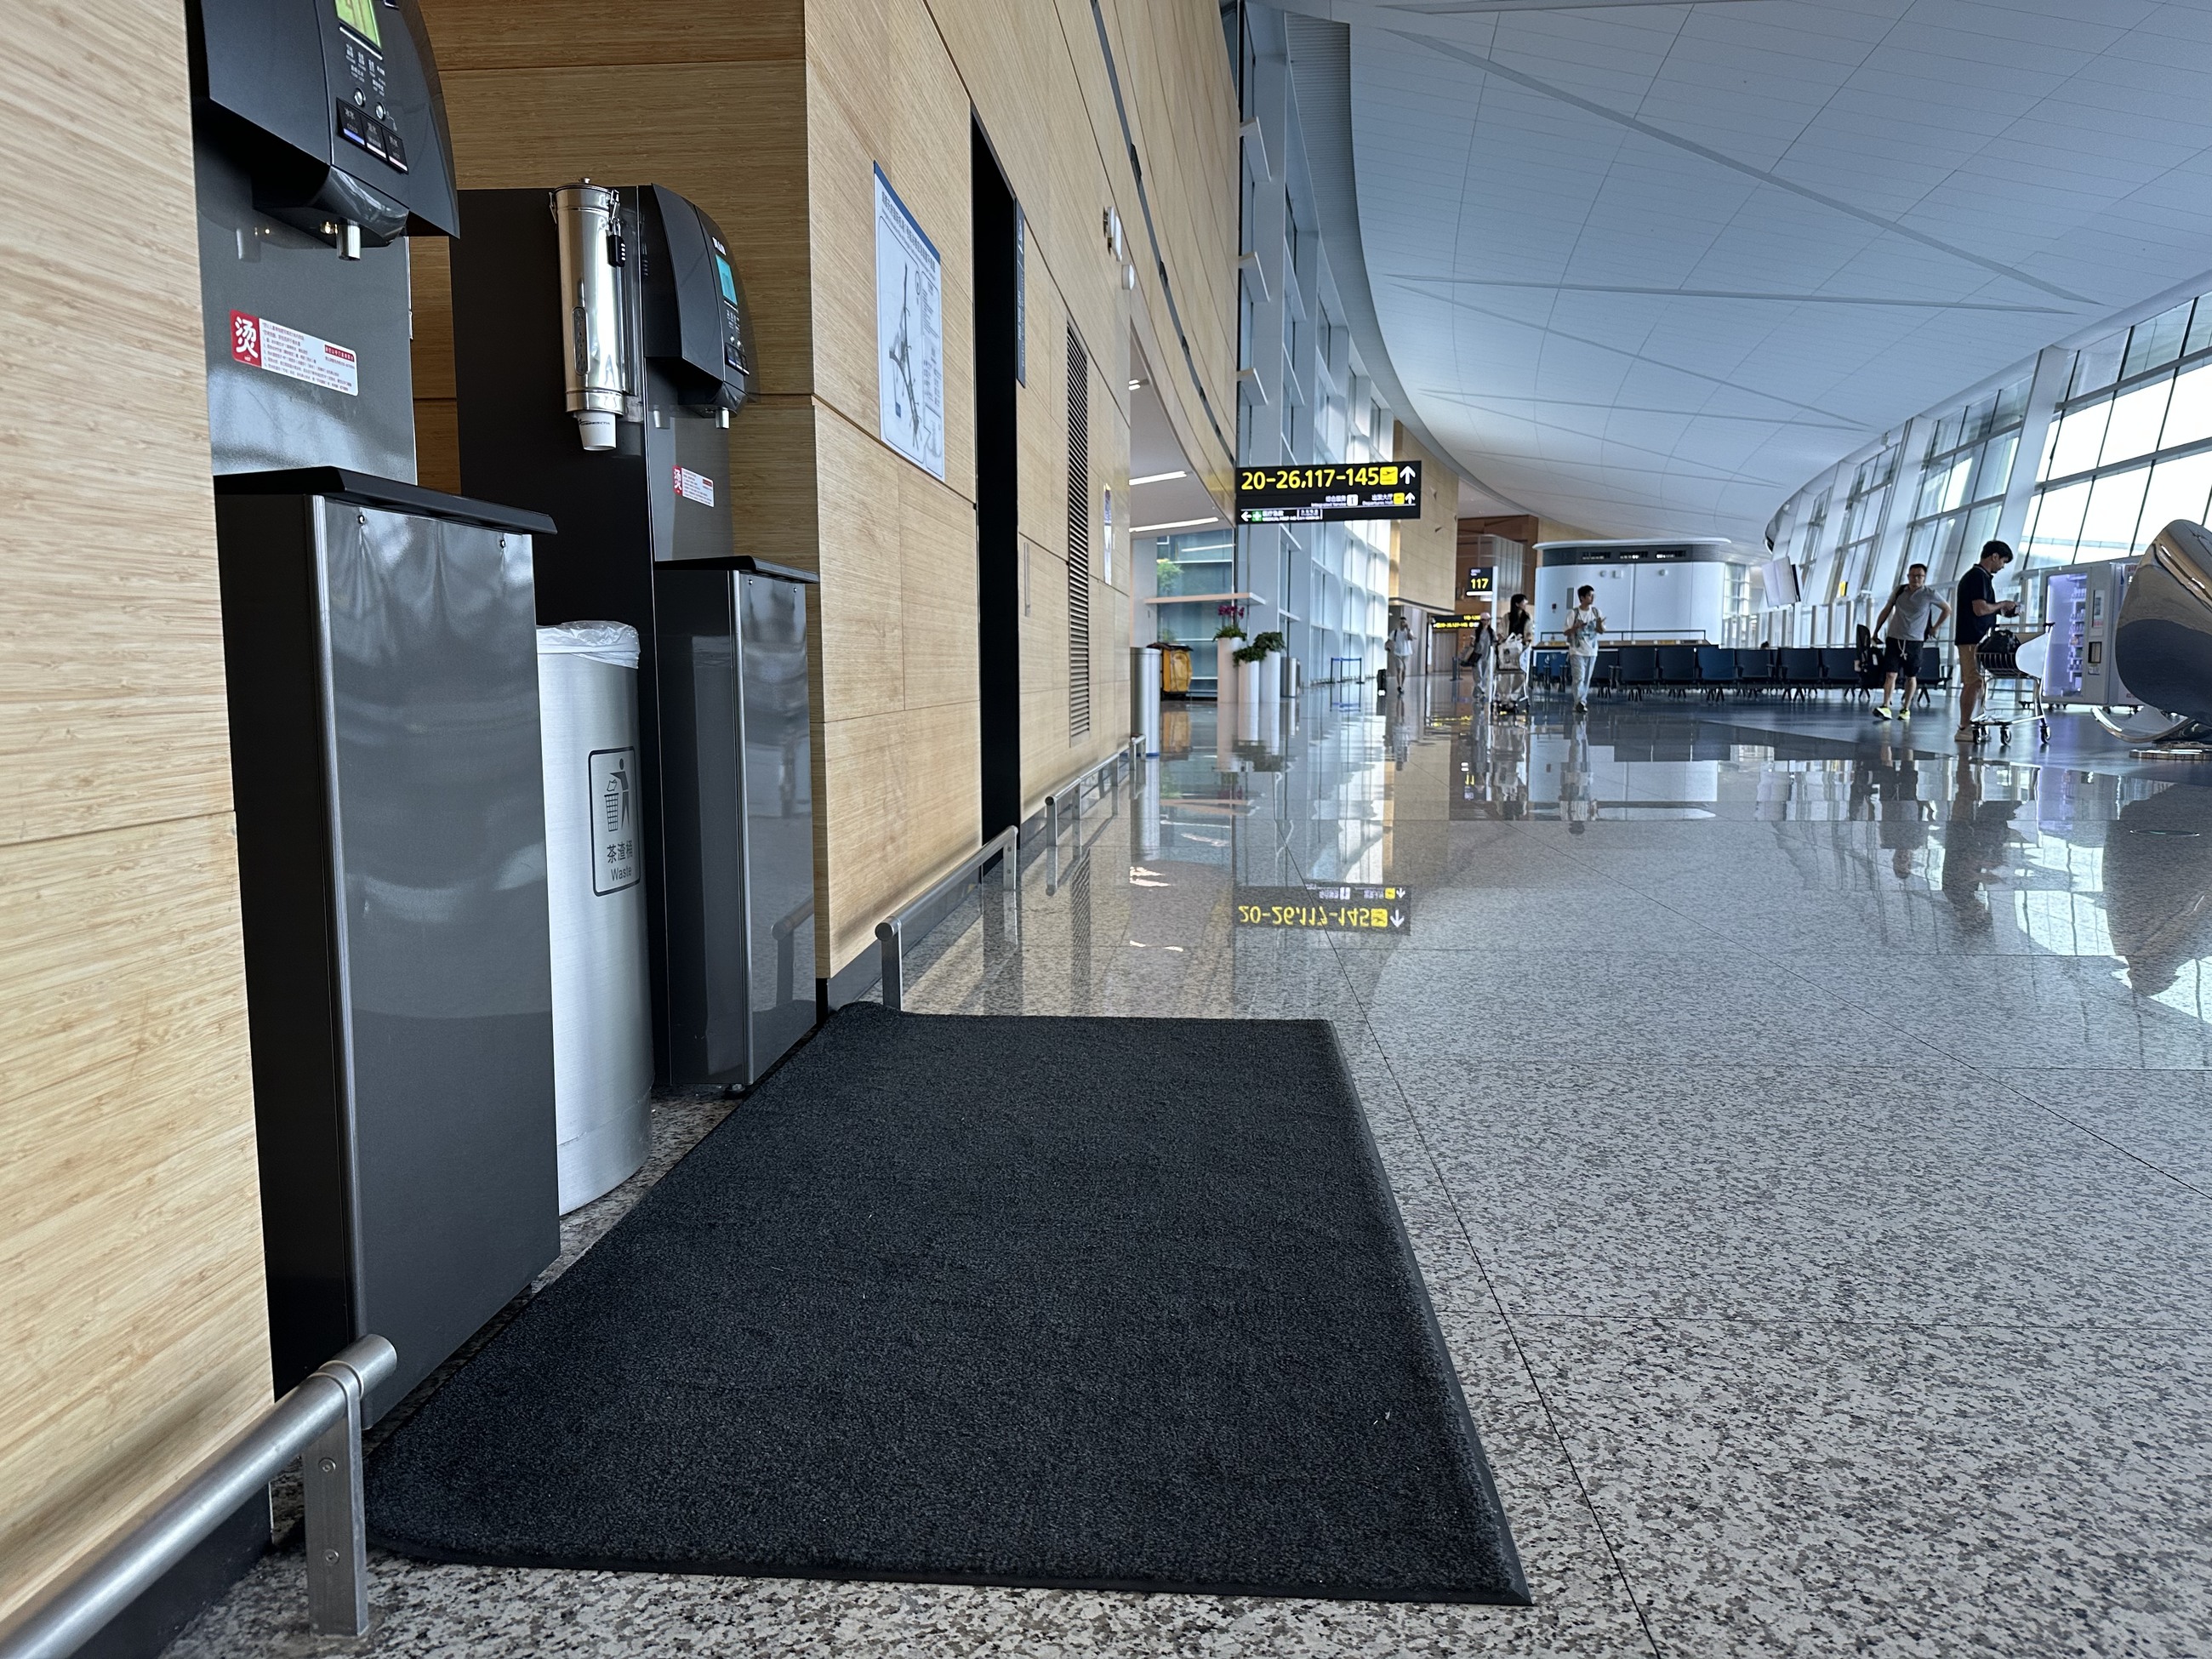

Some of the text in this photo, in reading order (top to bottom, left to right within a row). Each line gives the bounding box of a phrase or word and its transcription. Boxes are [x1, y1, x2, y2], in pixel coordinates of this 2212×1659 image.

[235, 316, 258, 358] 烫
[1241, 468, 1379, 490] 20-26,117-145
[1470, 578, 1489, 590] 117
[611, 865, 631, 881] Waste
